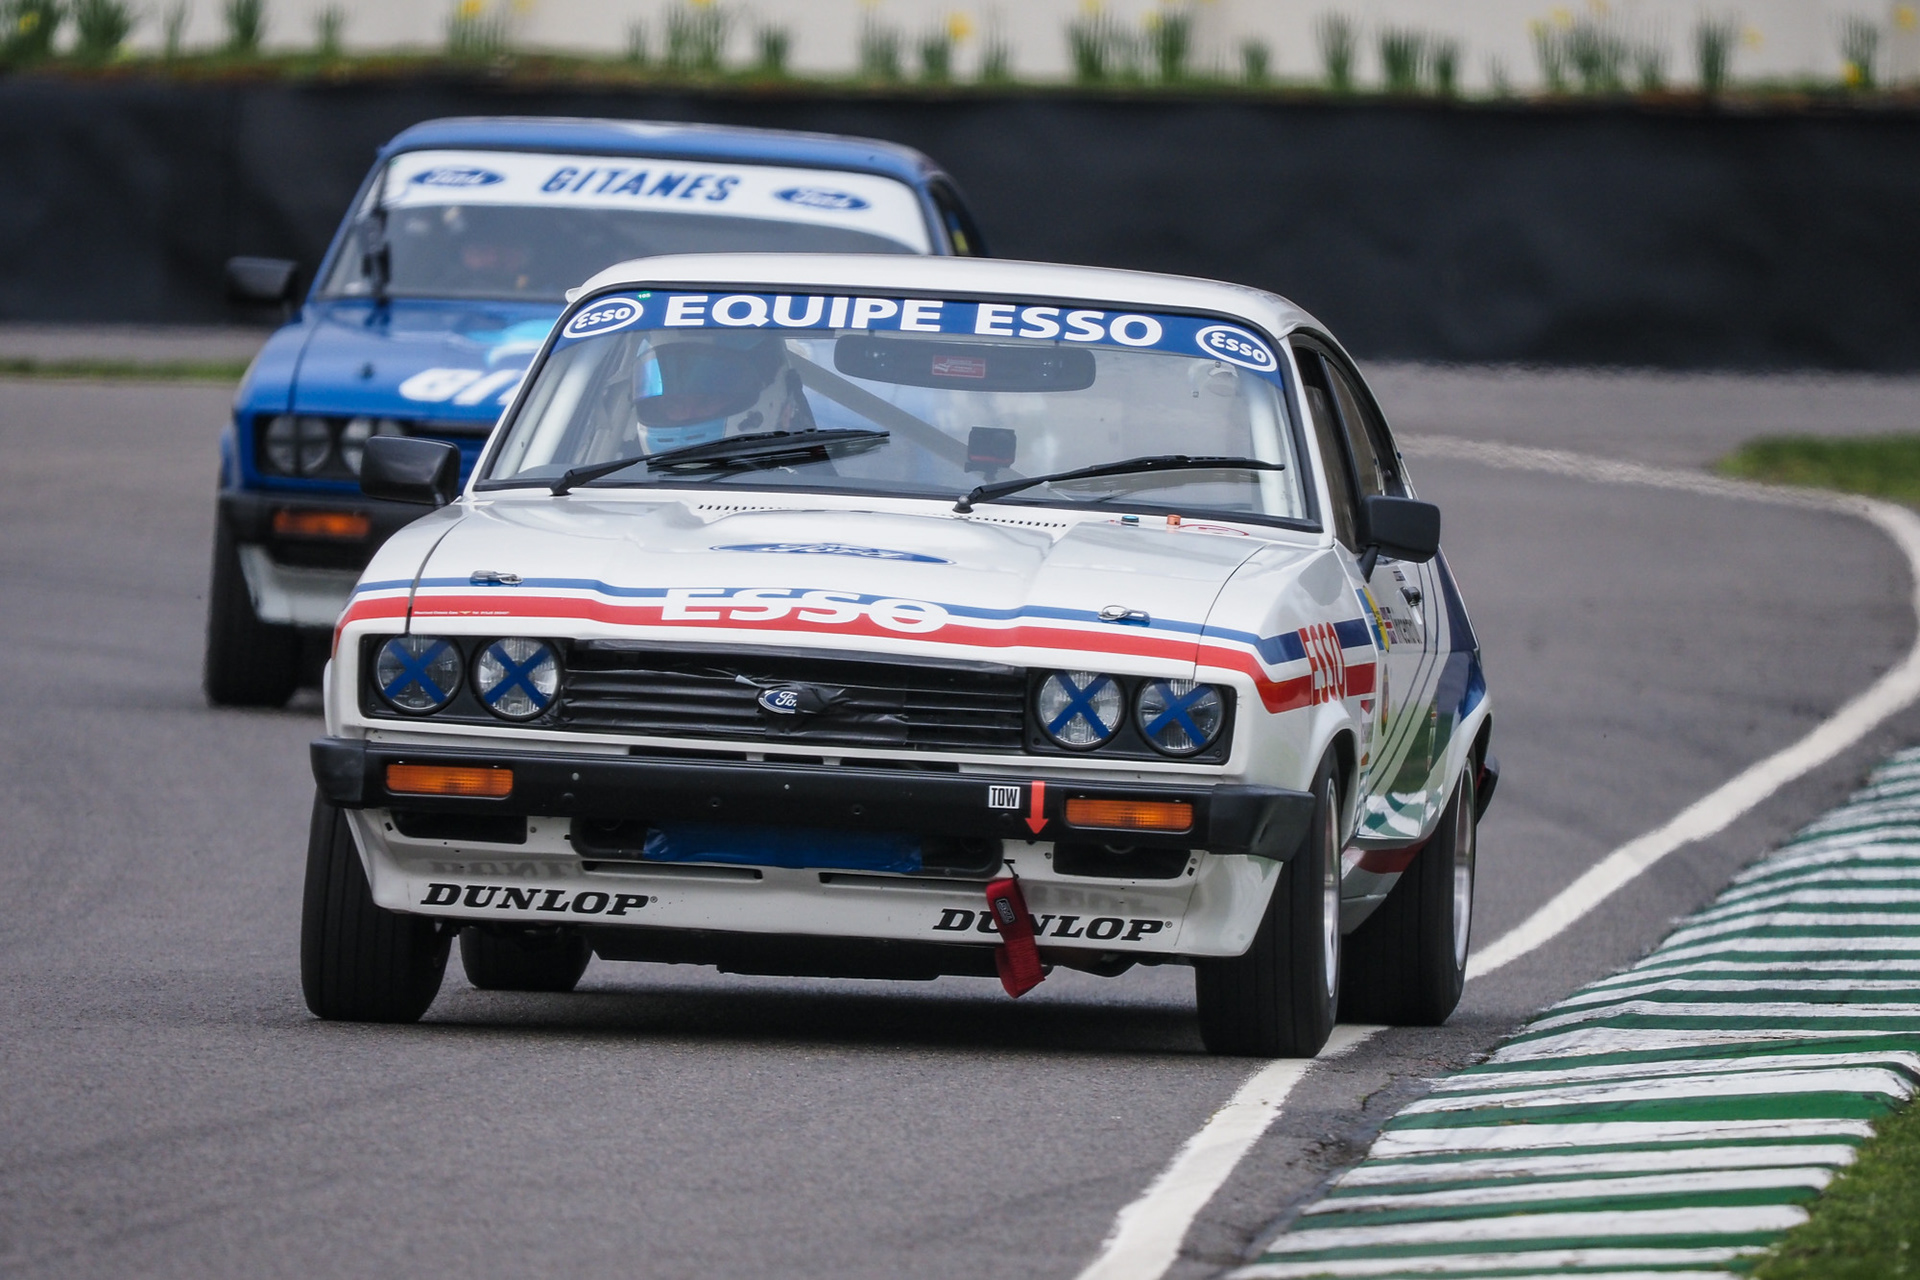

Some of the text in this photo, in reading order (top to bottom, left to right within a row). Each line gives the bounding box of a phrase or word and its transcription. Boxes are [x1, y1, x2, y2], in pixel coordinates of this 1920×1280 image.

[541, 166, 741, 202] GITANES
[663, 295, 1162, 347] EQUIPE ESSO
[661, 588, 949, 633] ESSO
[1298, 621, 1345, 706] ESSO
[991, 788, 1018, 807] TOW
